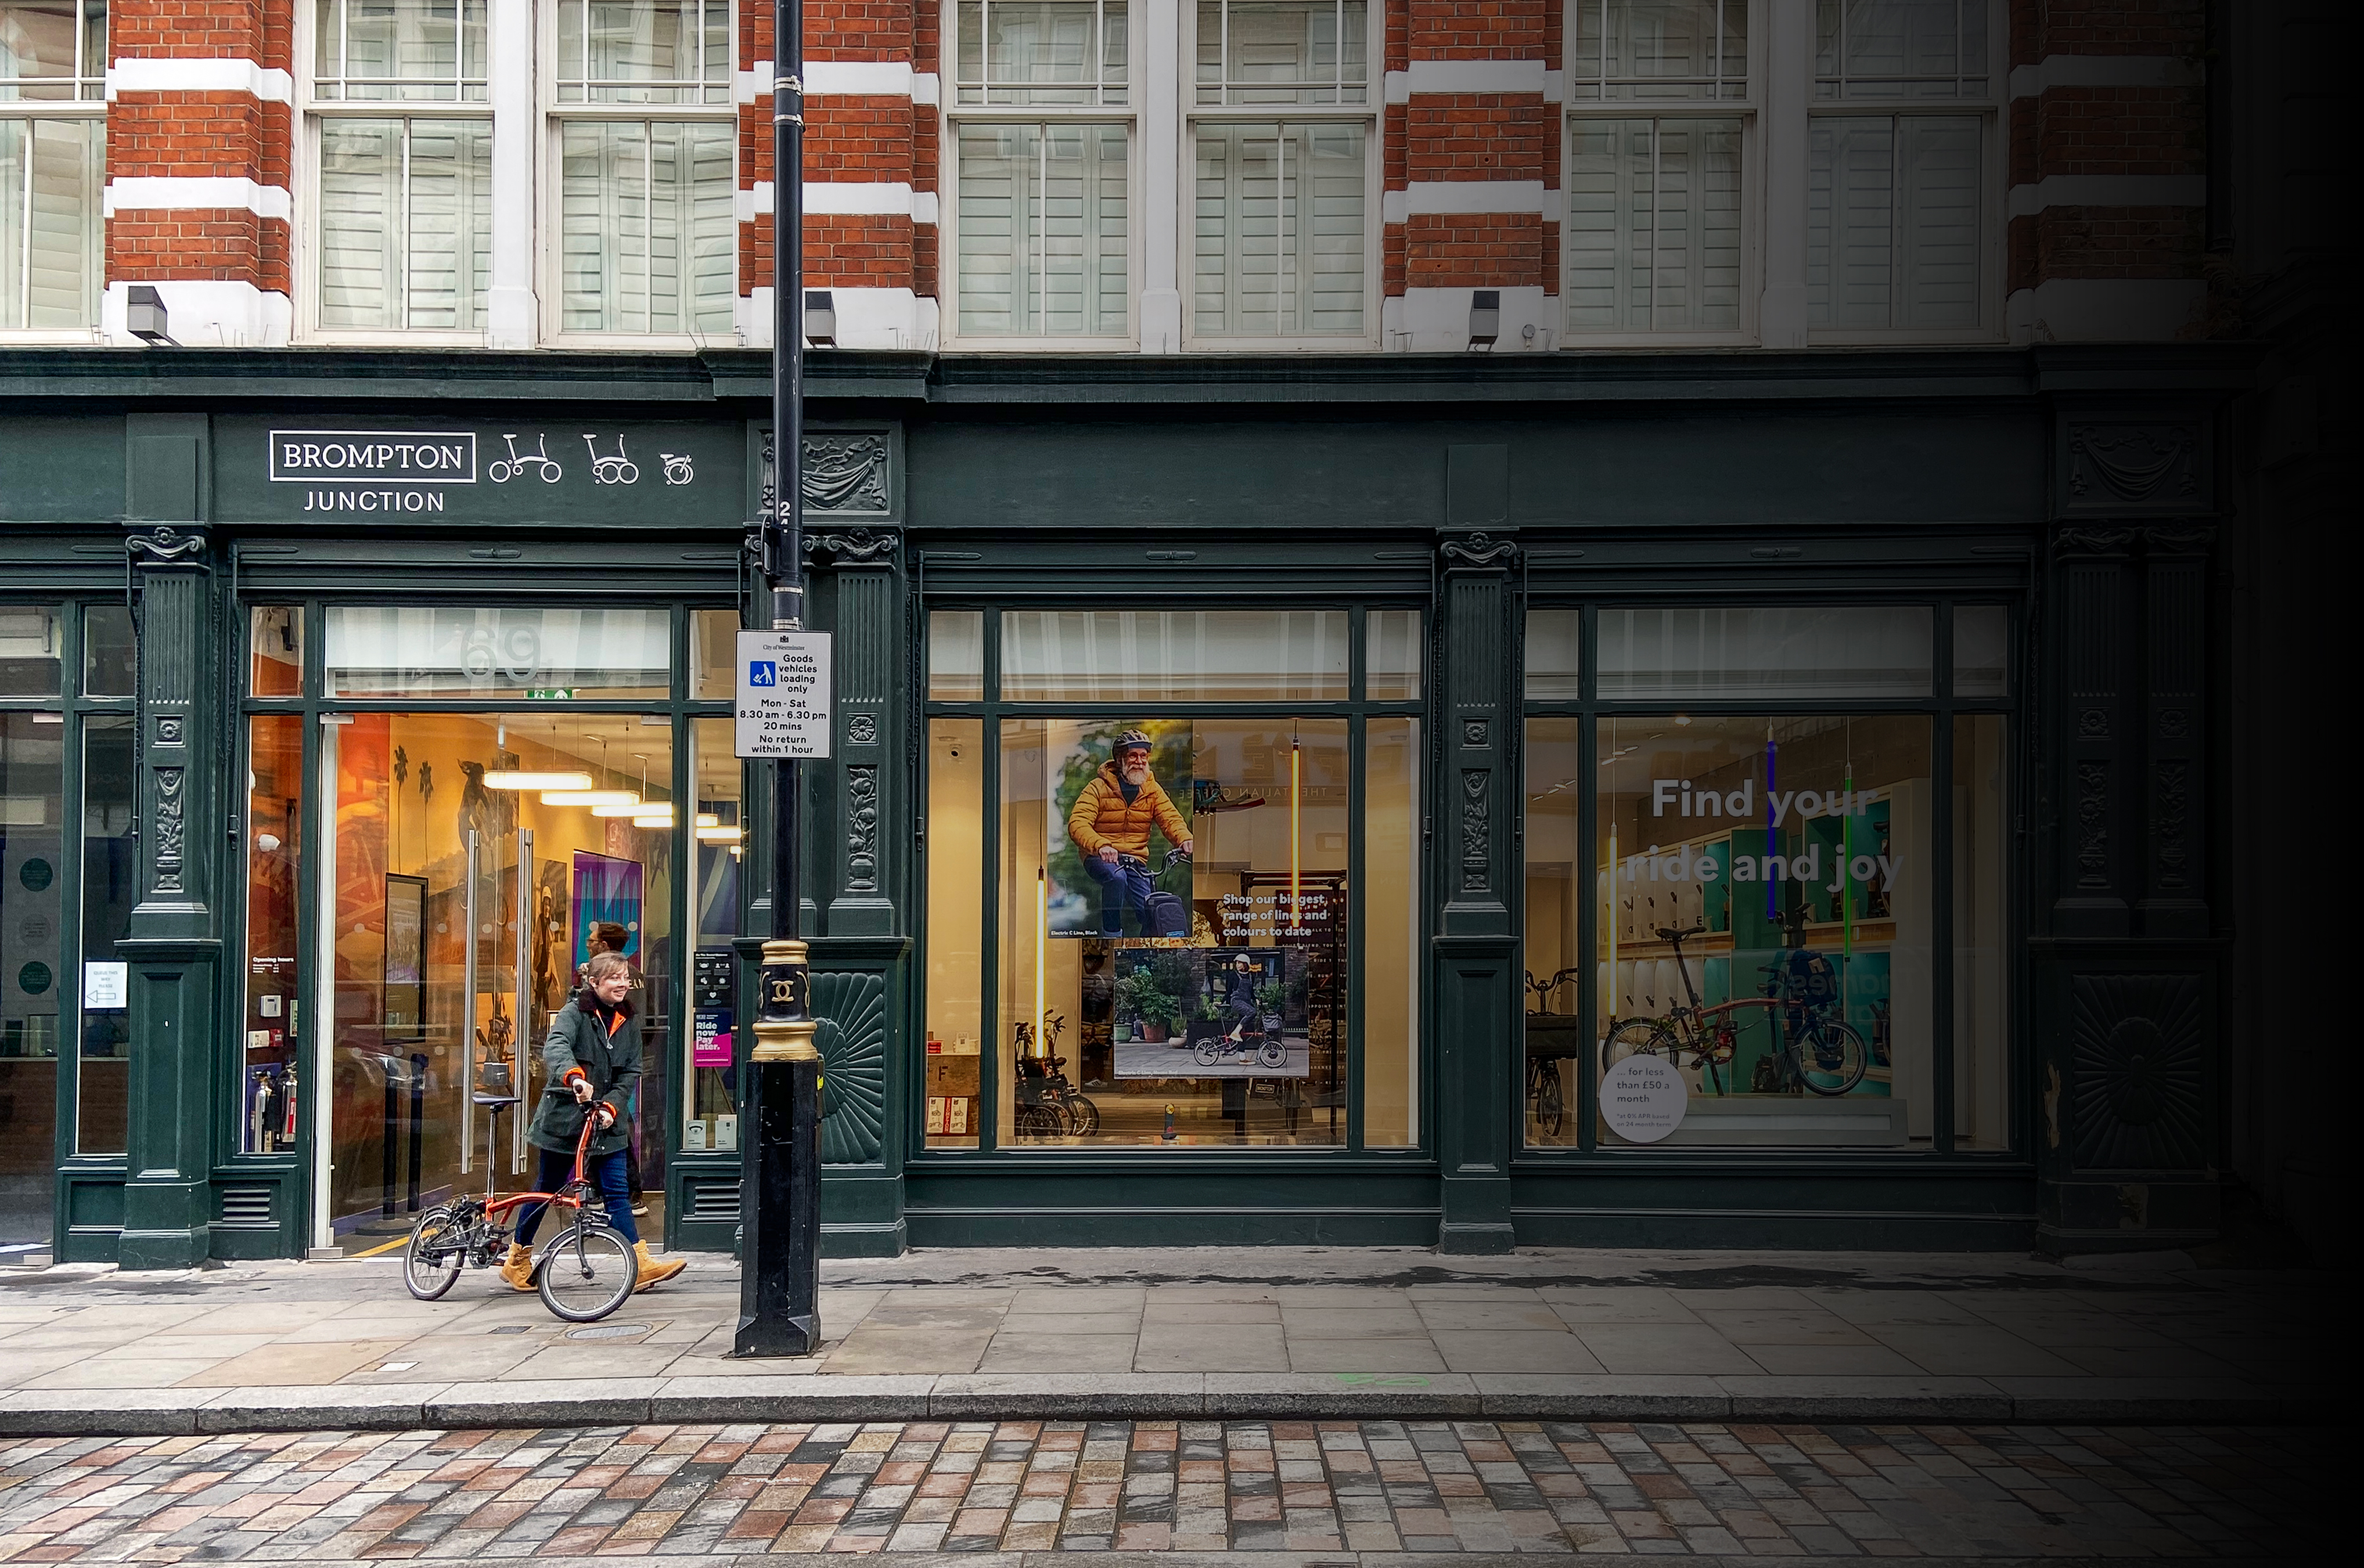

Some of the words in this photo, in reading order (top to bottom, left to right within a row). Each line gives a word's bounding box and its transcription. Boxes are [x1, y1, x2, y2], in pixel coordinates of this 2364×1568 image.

[283, 444, 463, 470] BROMPTON
[304, 491, 444, 512] JUNCTION
[459, 625, 540, 682] 69
[783, 654, 814, 663] Goods
[779, 665, 818, 673] vehicles
[780, 675, 815, 684] loading
[787, 685, 808, 694] only
[761, 699, 781, 707] Mon
[789, 700, 807, 708] Sat
[740, 710, 763, 718] 8.30
[787, 711, 810, 719] 6.30
[764, 722, 777, 730] 20
[780, 722, 802, 730] mins
[760, 735, 773, 743] No
[751, 745, 781, 754] within
[784, 745, 788, 754] 1
[792, 745, 814, 754] hour
[1653, 778, 1753, 818] Find
[1767, 787, 1879, 828] your
[1625, 844, 1719, 882] ride
[1732, 844, 1819, 882] and
[1826, 844, 1905, 893] joy
[1222, 893, 1254, 907] Shop
[1255, 896, 1278, 904] our
[1222, 911, 1258, 923] range
[1260, 909, 1274, 921] of
[1275, 909, 1302, 921] lines
[1304, 909, 1327, 921] and
[1222, 925, 1267, 936] colours
[1269, 927, 1283, 936] to
[1284, 925, 1312, 936] date
[696, 1022, 718, 1030] Ride
[1628, 1067, 1643, 1076] for
[1646, 1067, 1664, 1076] less
[1617, 1080, 1639, 1090] than
[1642, 1080, 1662, 1090] £50
[1617, 1094, 1650, 1103] month
